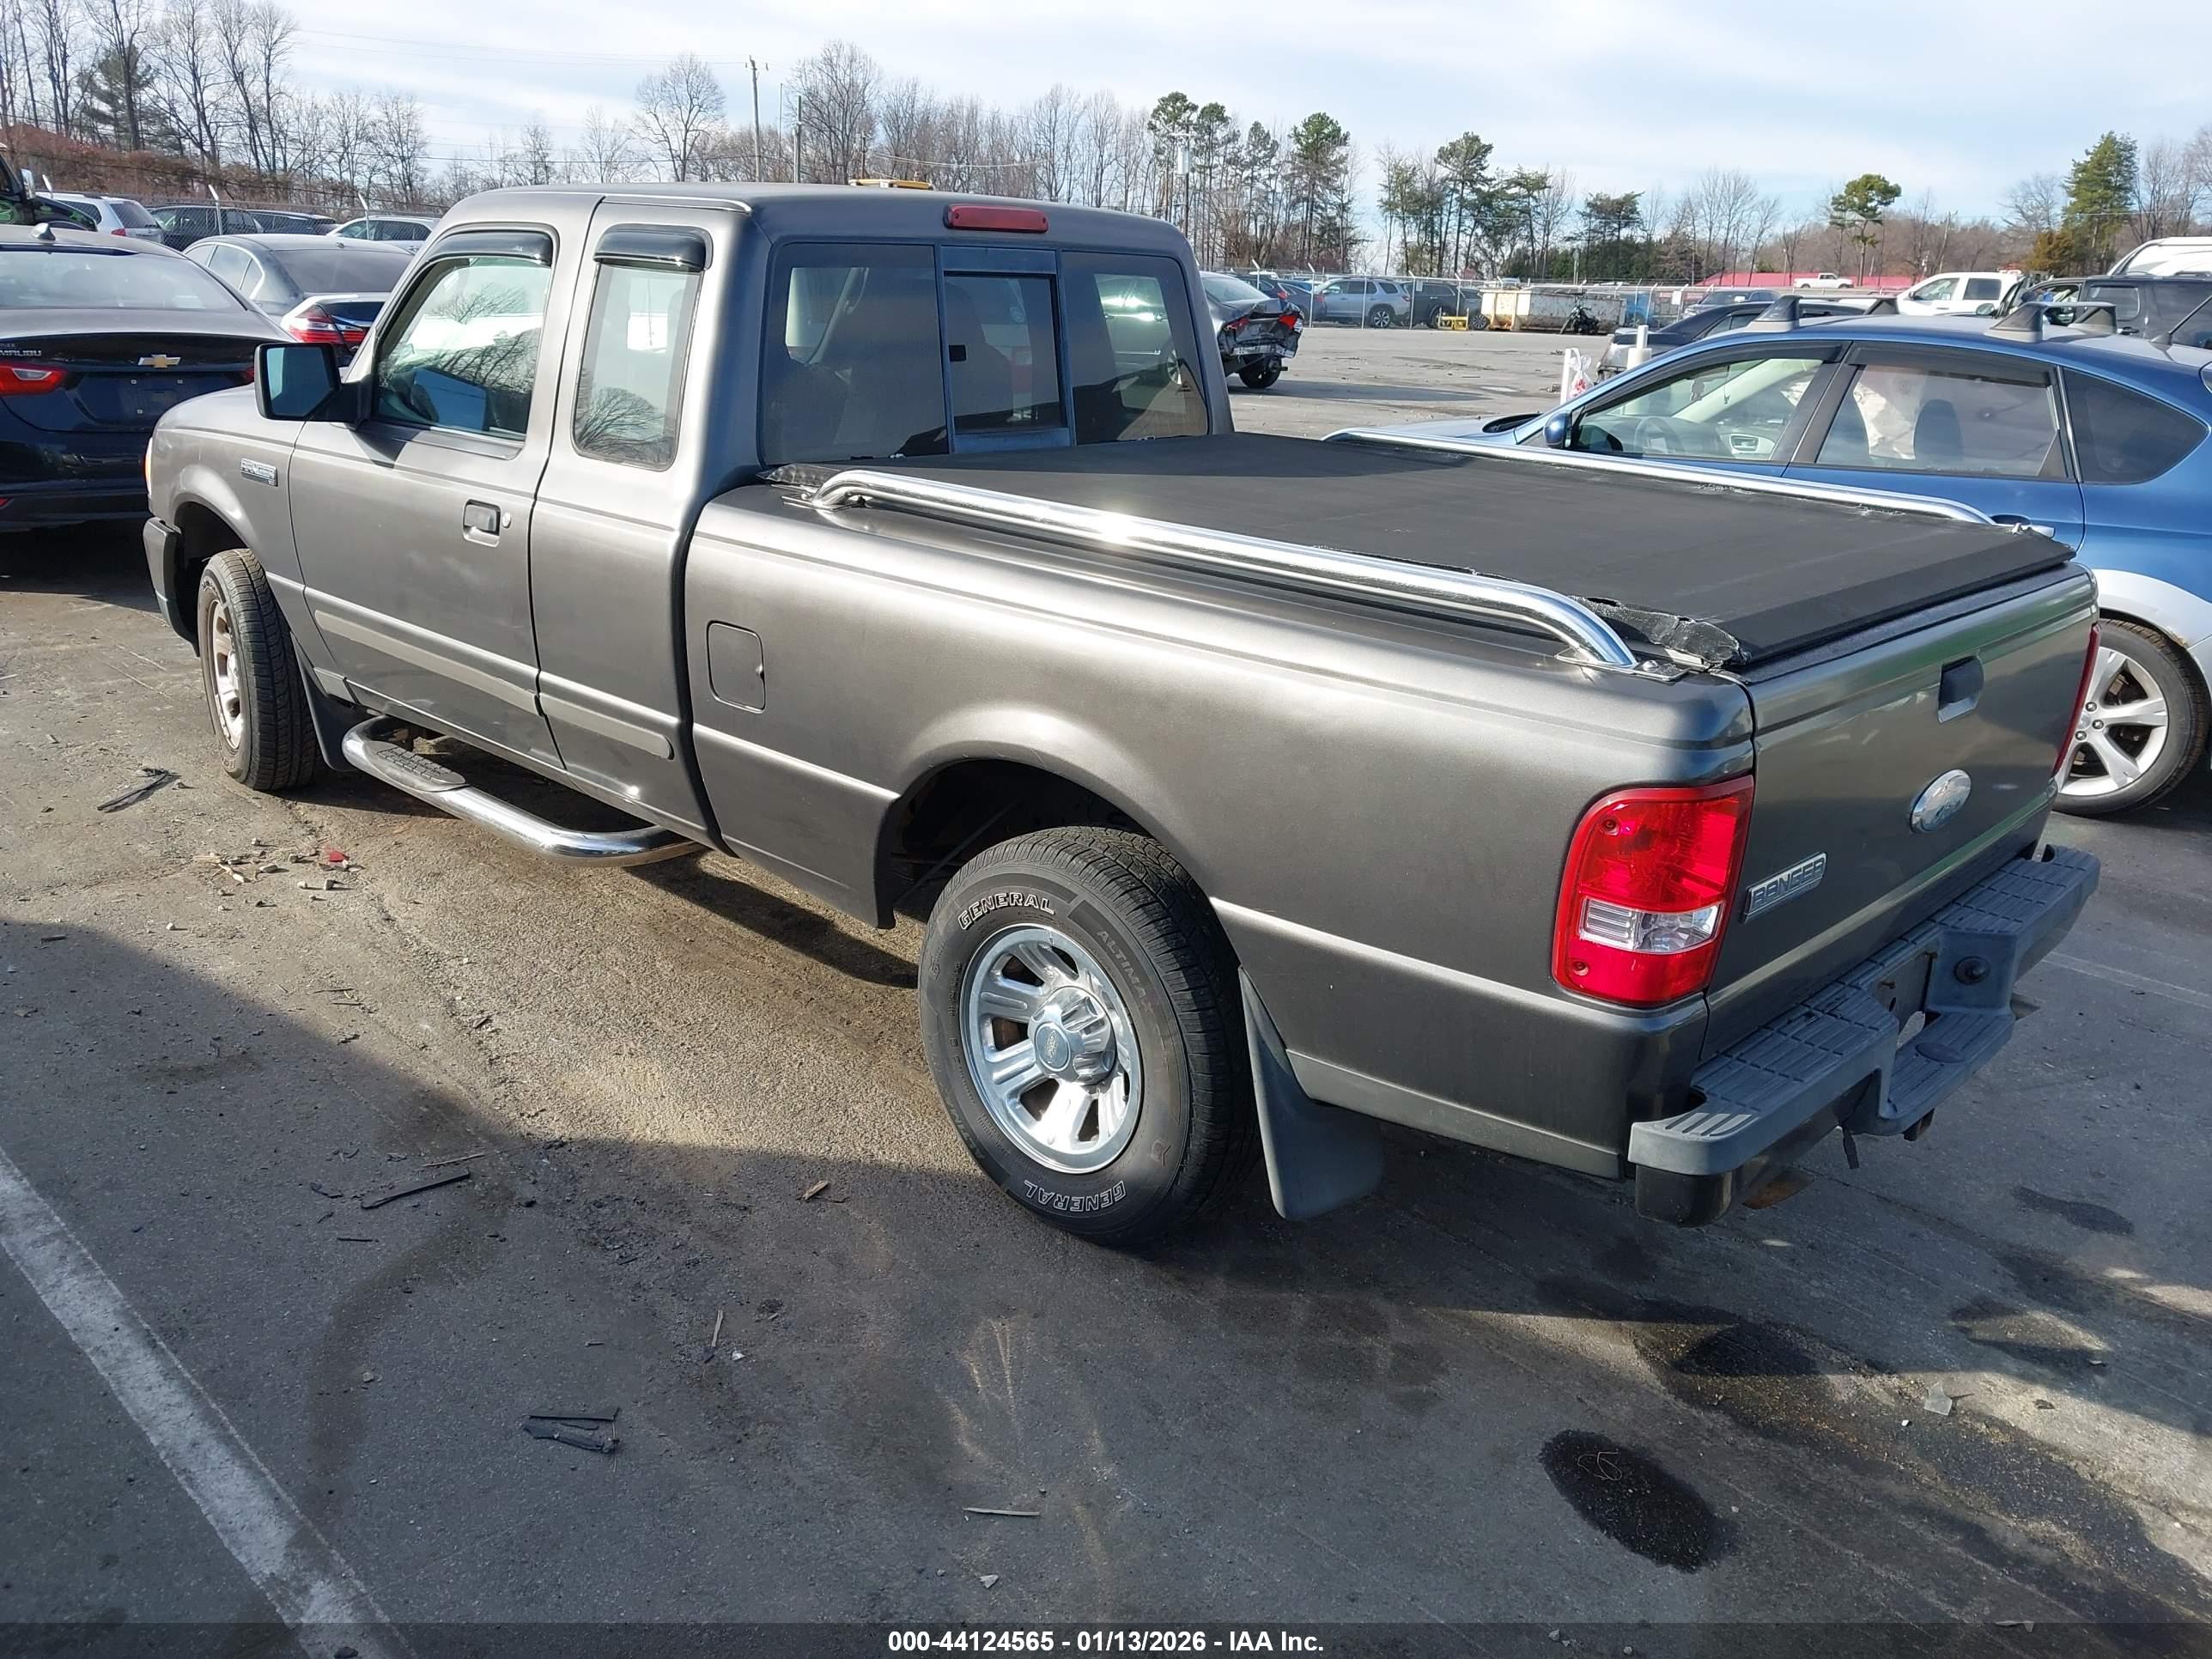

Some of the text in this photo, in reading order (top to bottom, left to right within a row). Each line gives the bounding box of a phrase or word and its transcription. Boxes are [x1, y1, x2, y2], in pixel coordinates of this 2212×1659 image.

[1751, 857, 1825, 910] RANGER
[957, 892, 1056, 930] GENERAL
[1024, 1179, 1127, 1212] GENERAL
